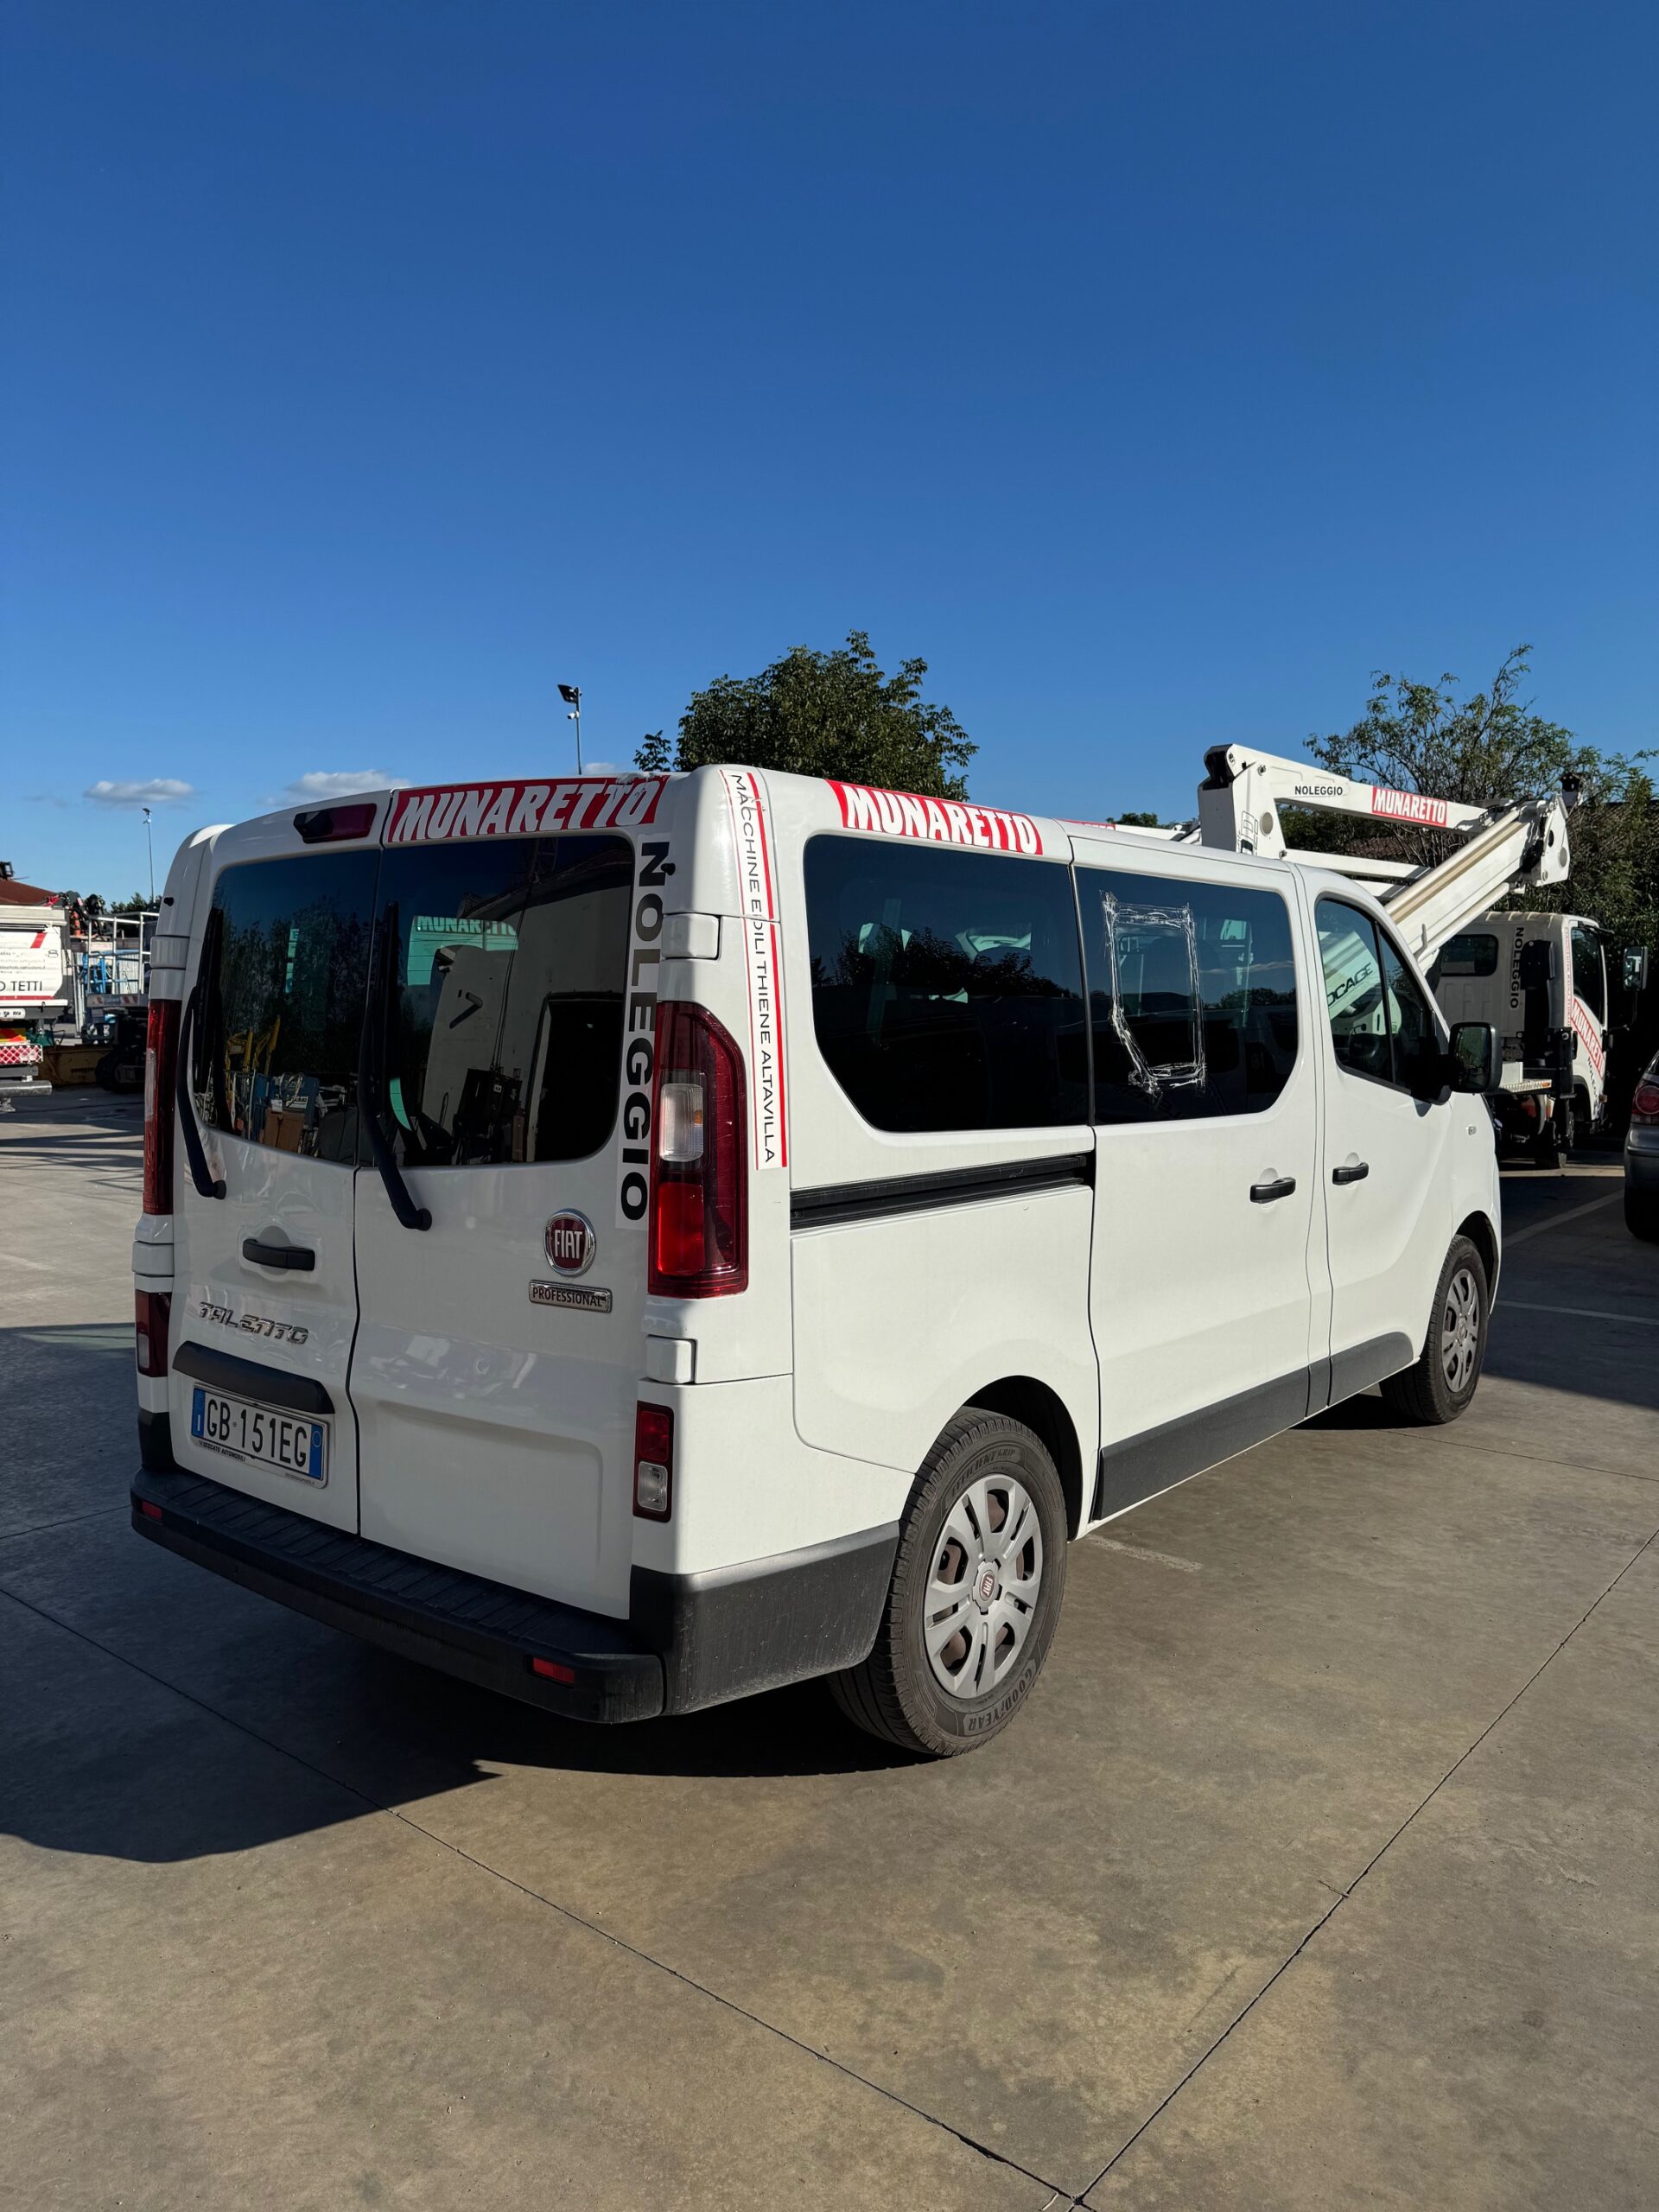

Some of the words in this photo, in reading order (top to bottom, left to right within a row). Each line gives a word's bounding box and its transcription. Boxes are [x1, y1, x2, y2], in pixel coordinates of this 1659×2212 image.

[391, 780, 661, 842] MUNARETTO
[841, 784, 1037, 855] MUNARETTO
[1294, 785, 1344, 796] NOLEGGIO
[1373, 788, 1446, 823] MUNARETTO
[730, 774, 760, 893] MACCHINE
[751, 899, 766, 955] EDILI
[10, 981, 42, 992] TETTI
[1510, 927, 1525, 1009] NOLEGGIO
[620, 841, 670, 1222] NOLEGGIO
[756, 961, 771, 1044] THIENE
[761, 1050, 775, 1163] ALTAVILLA
[554, 1229, 583, 1260] FIAT
[199, 1301, 309, 1345] TALENTO
[532, 1286, 603, 1307] PROFESSIONAL
[982, 1575, 994, 1597] FIAT
[968, 1668, 1033, 1732] GOODYEAR
